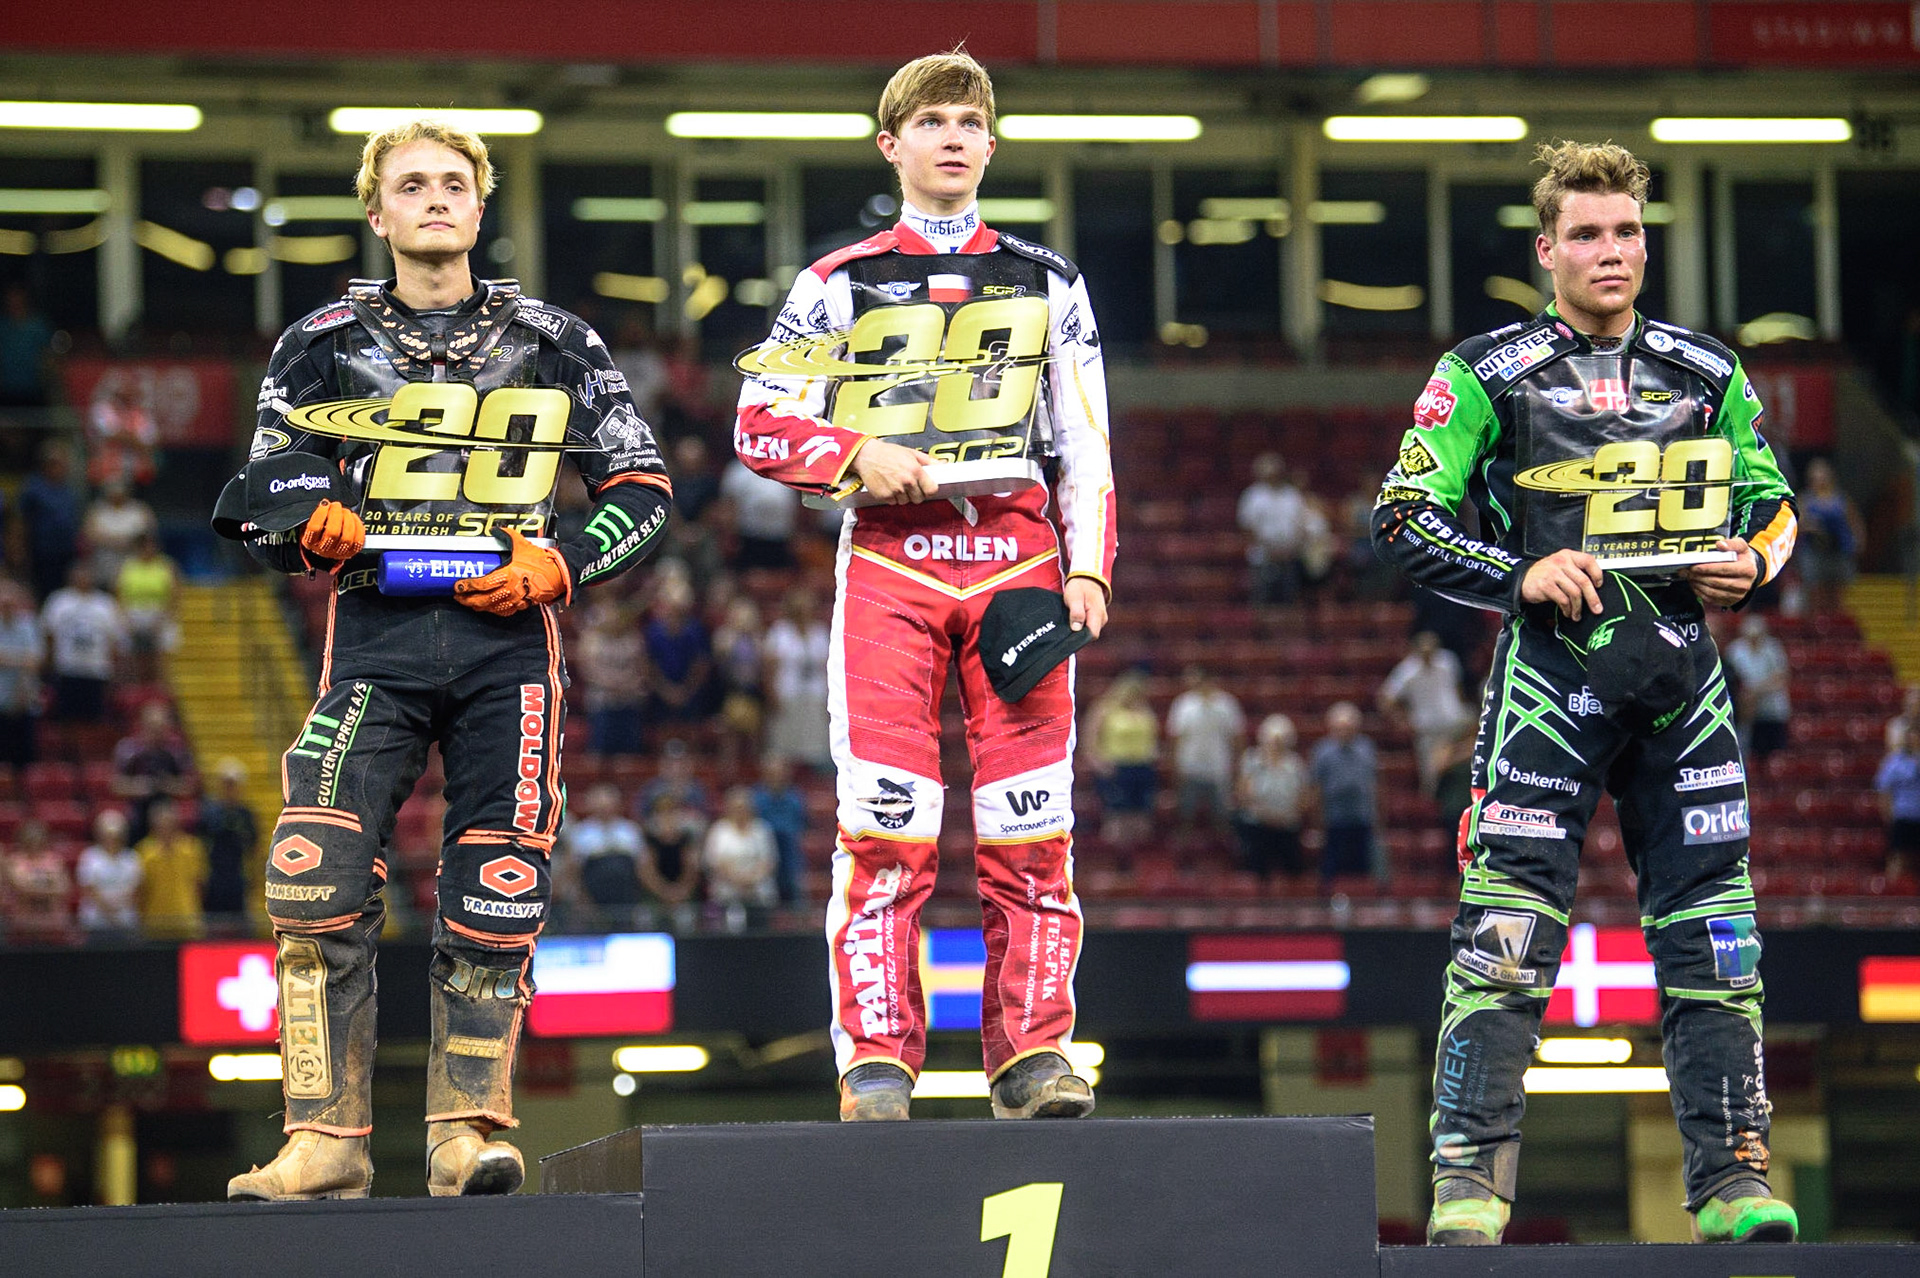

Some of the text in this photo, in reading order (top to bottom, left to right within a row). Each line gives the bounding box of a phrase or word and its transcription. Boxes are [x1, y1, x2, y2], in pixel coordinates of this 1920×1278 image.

[831, 297, 1049, 436] 20
[1641, 390, 1682, 404] SGP2
[369, 382, 571, 504] 20
[735, 425, 789, 460] LEN
[1587, 438, 1733, 535] 20
[365, 511, 453, 522] 20 YEARS OF
[391, 525, 449, 536] BRITISH
[904, 534, 1018, 562] ORLEN
[1403, 528, 1423, 547] RØR
[1455, 556, 1506, 580] MONTAGE
[1602, 542, 1638, 551] YEARS
[1641, 541, 1655, 549] OF
[352, 682, 368, 707] A/S
[512, 683, 545, 832] MOLDOW
[1509, 766, 1581, 796] bakertilly
[880, 817, 904, 829] PZM
[1000, 814, 1065, 835] SportoweFakty
[1500, 809, 1551, 825] BYGMA
[1500, 825, 1519, 835] FOR
[463, 897, 544, 917] TRANSLYFT
[885, 958, 897, 983] BEZ
[1041, 916, 1061, 1002] TEK-PAK
[1490, 967, 1497, 976] &
[1500, 971, 1535, 983] GRANIT
[887, 984, 901, 1035] WYROBY
[1019, 965, 1038, 1035] TEKTUROWYCH
[981, 1182, 1064, 1278] 1
